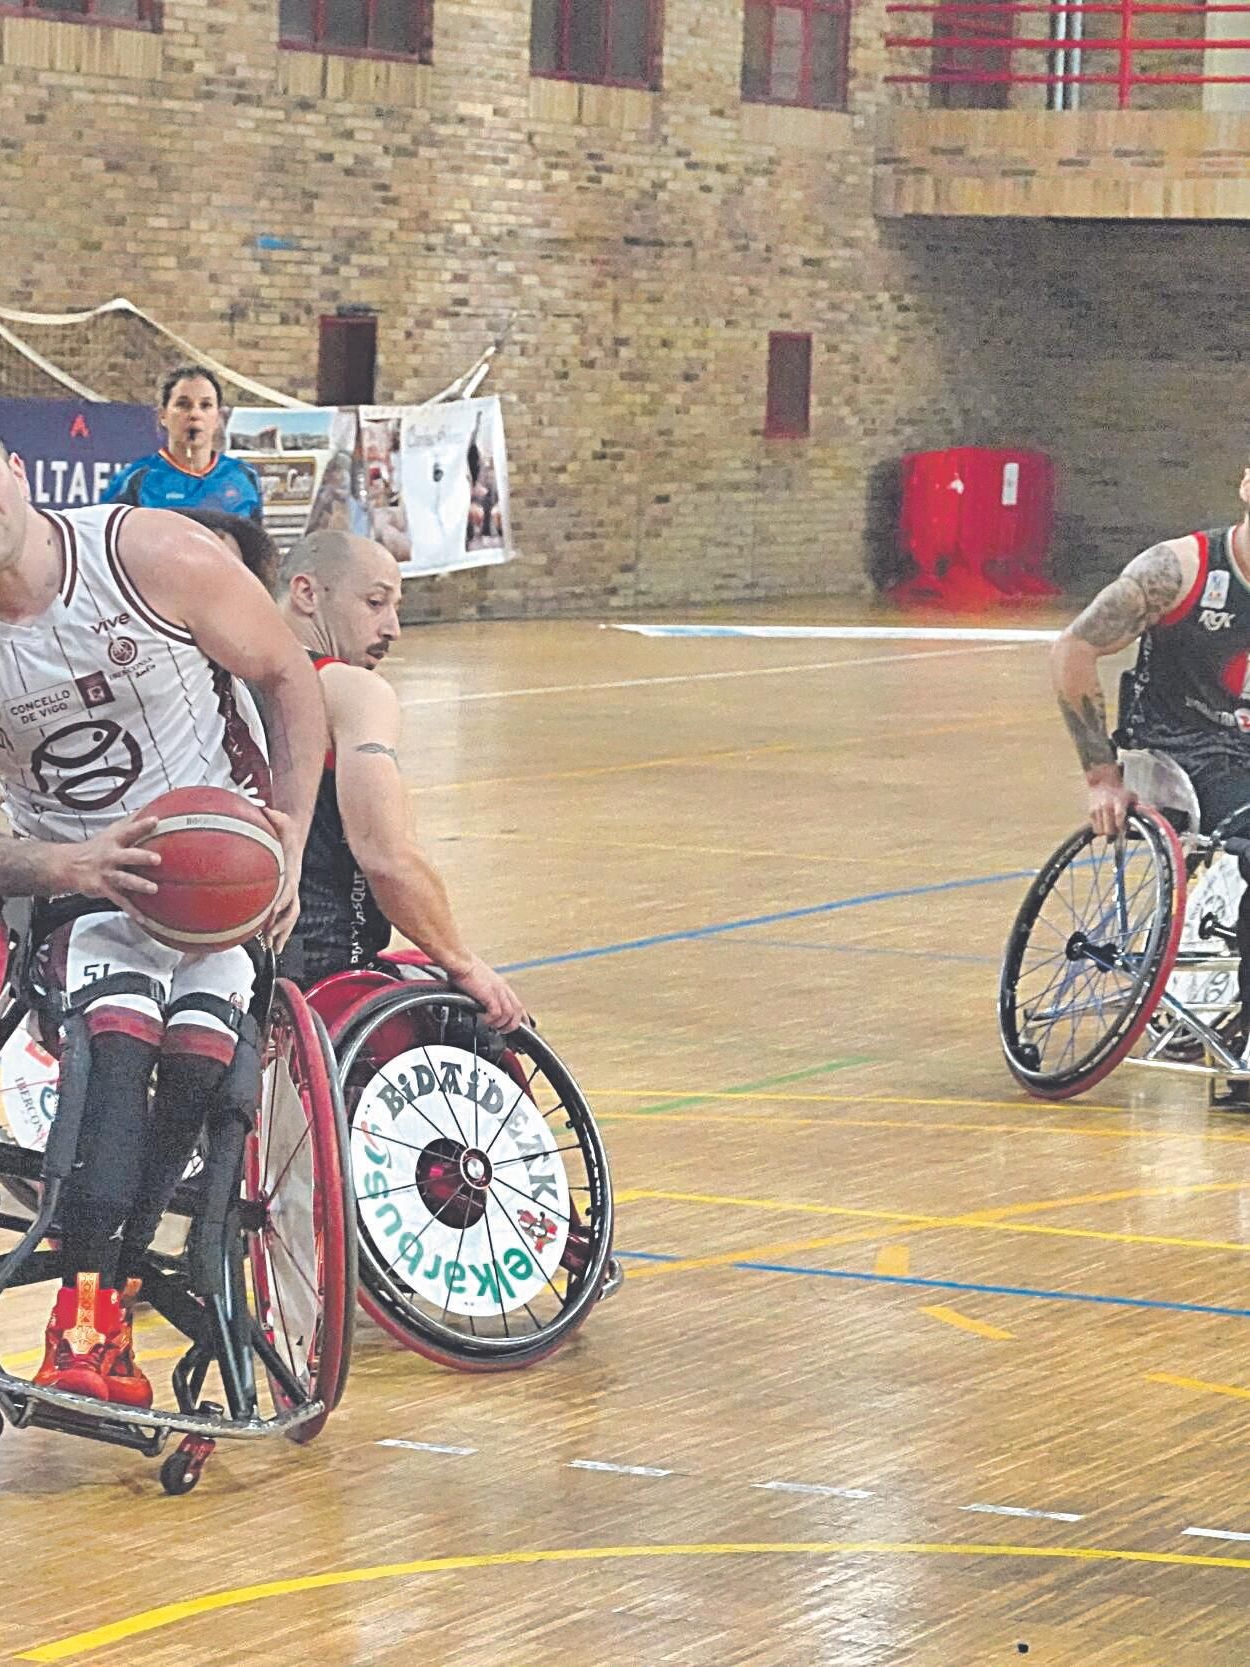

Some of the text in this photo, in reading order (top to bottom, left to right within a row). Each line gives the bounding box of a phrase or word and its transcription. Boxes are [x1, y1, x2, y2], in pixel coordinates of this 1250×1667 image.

[91, 611, 131, 635] vive
[10, 689, 71, 716] CONCELLO
[21, 702, 69, 725] DE VIGO
